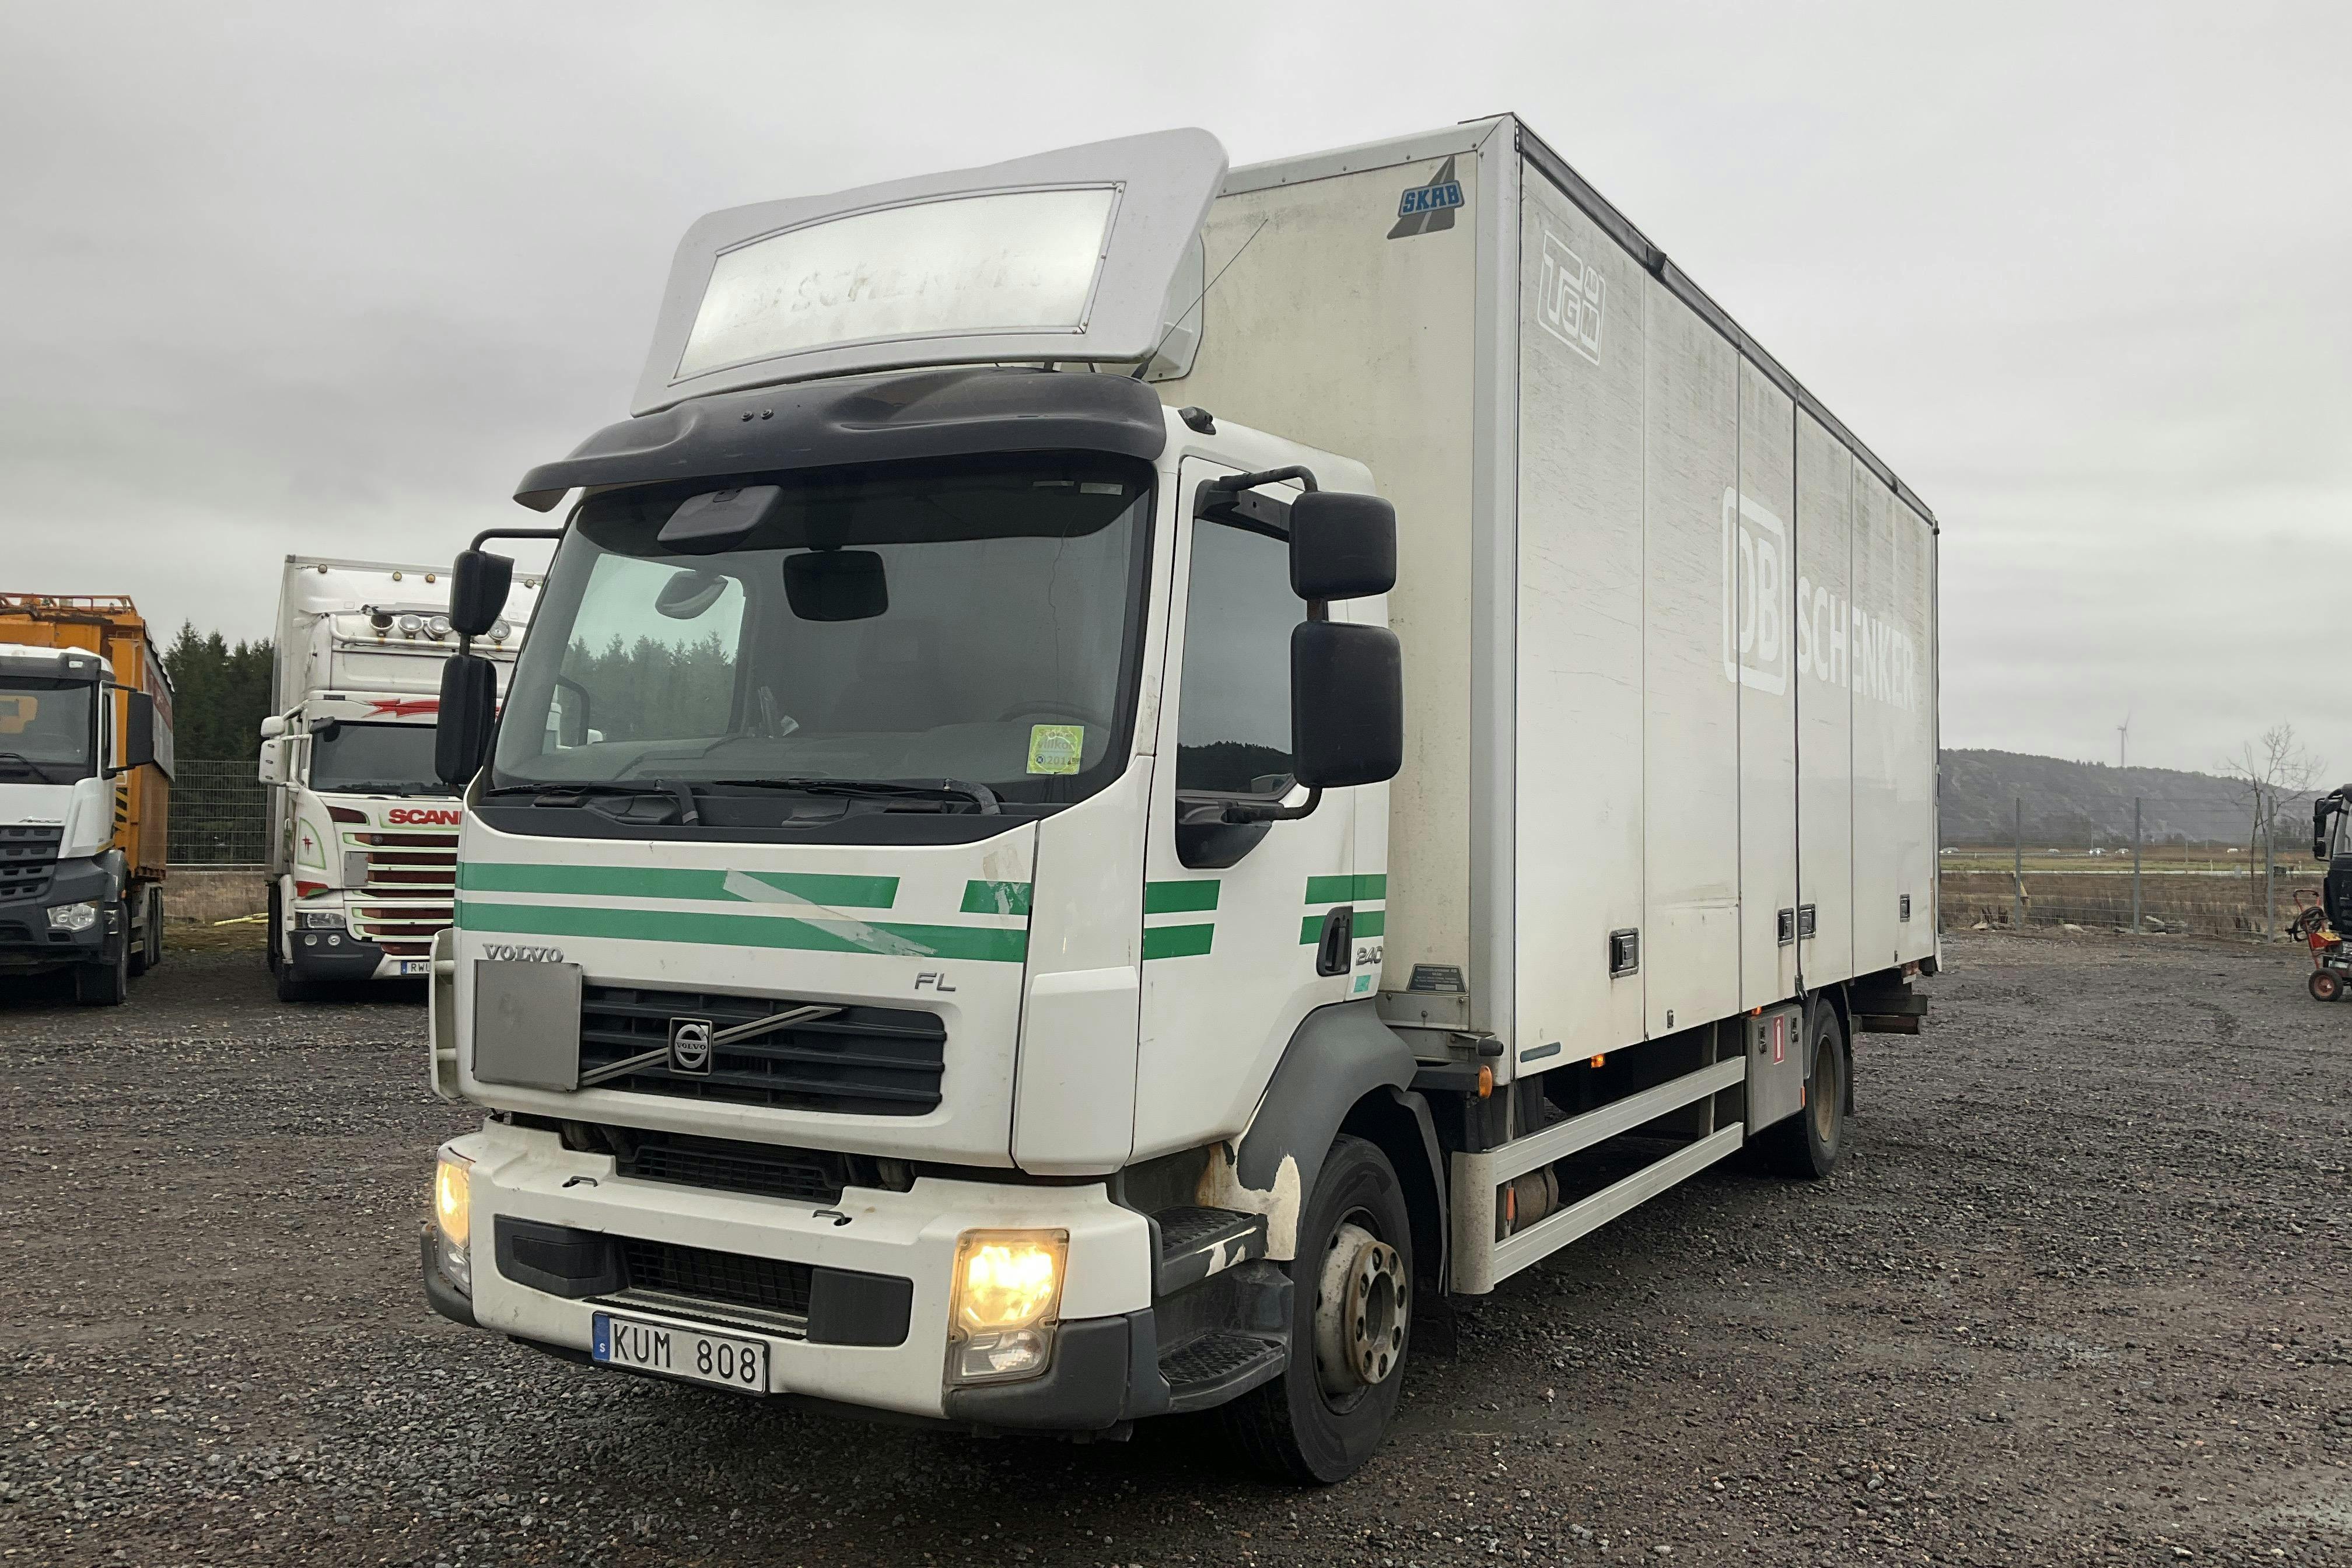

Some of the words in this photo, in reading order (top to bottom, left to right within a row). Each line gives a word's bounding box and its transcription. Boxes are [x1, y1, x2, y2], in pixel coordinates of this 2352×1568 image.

[1402, 184, 1460, 214] SKAB
[1732, 522, 1780, 663] DB
[1796, 576, 1915, 713] SCHENKER
[482, 943, 564, 963] VOLVO
[1355, 946, 1382, 966] 240
[914, 971, 957, 992] FL
[676, 1042, 706, 1050] VOLVO
[599, 1342, 606, 1353] S
[614, 1323, 671, 1368] KUM
[697, 1339, 756, 1384] 808
